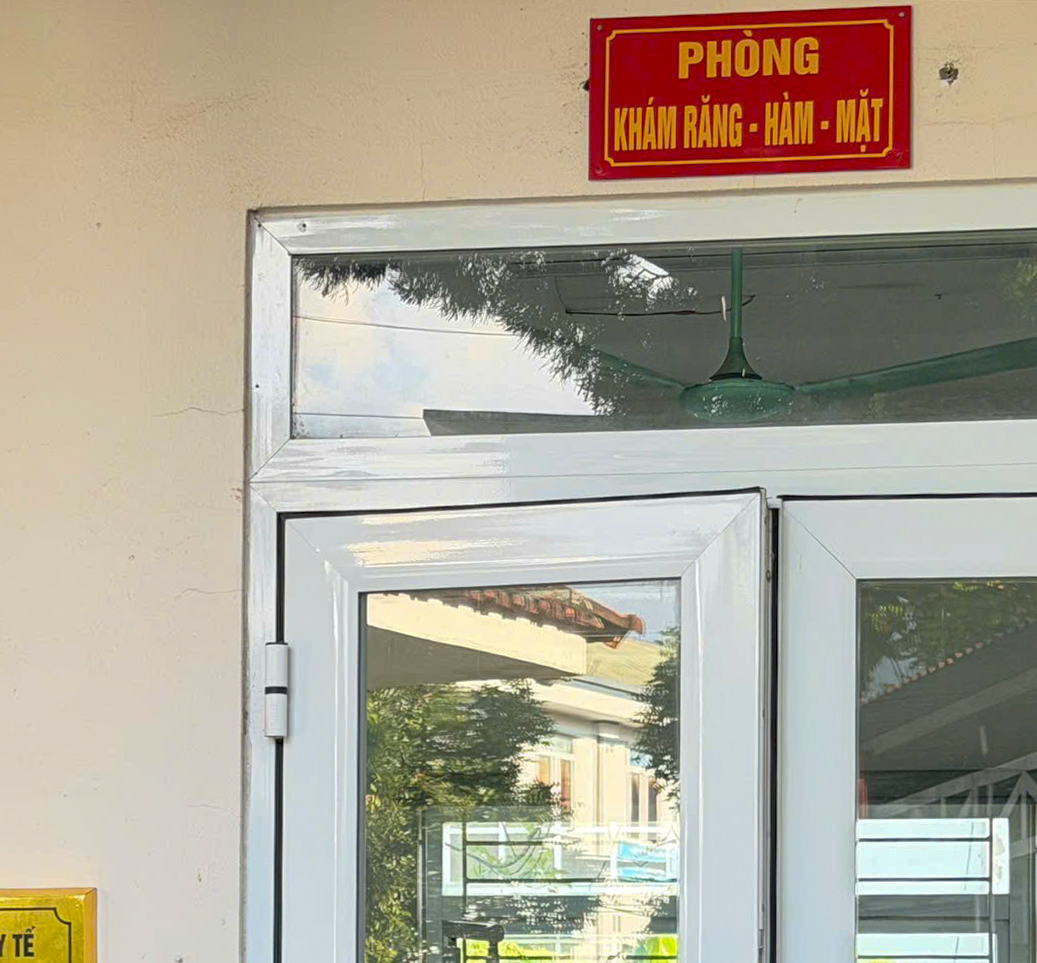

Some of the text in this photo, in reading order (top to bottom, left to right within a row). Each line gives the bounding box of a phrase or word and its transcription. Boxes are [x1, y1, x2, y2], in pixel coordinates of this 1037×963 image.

[678, 30, 820, 79] PHÒNG
[614, 96, 676, 151] KHÁM
[683, 95, 743, 149] RĂNG
[764, 91, 814, 146] HÀM
[836, 88, 883, 153] MẶT
[12, 926, 36, 957] TẾ
